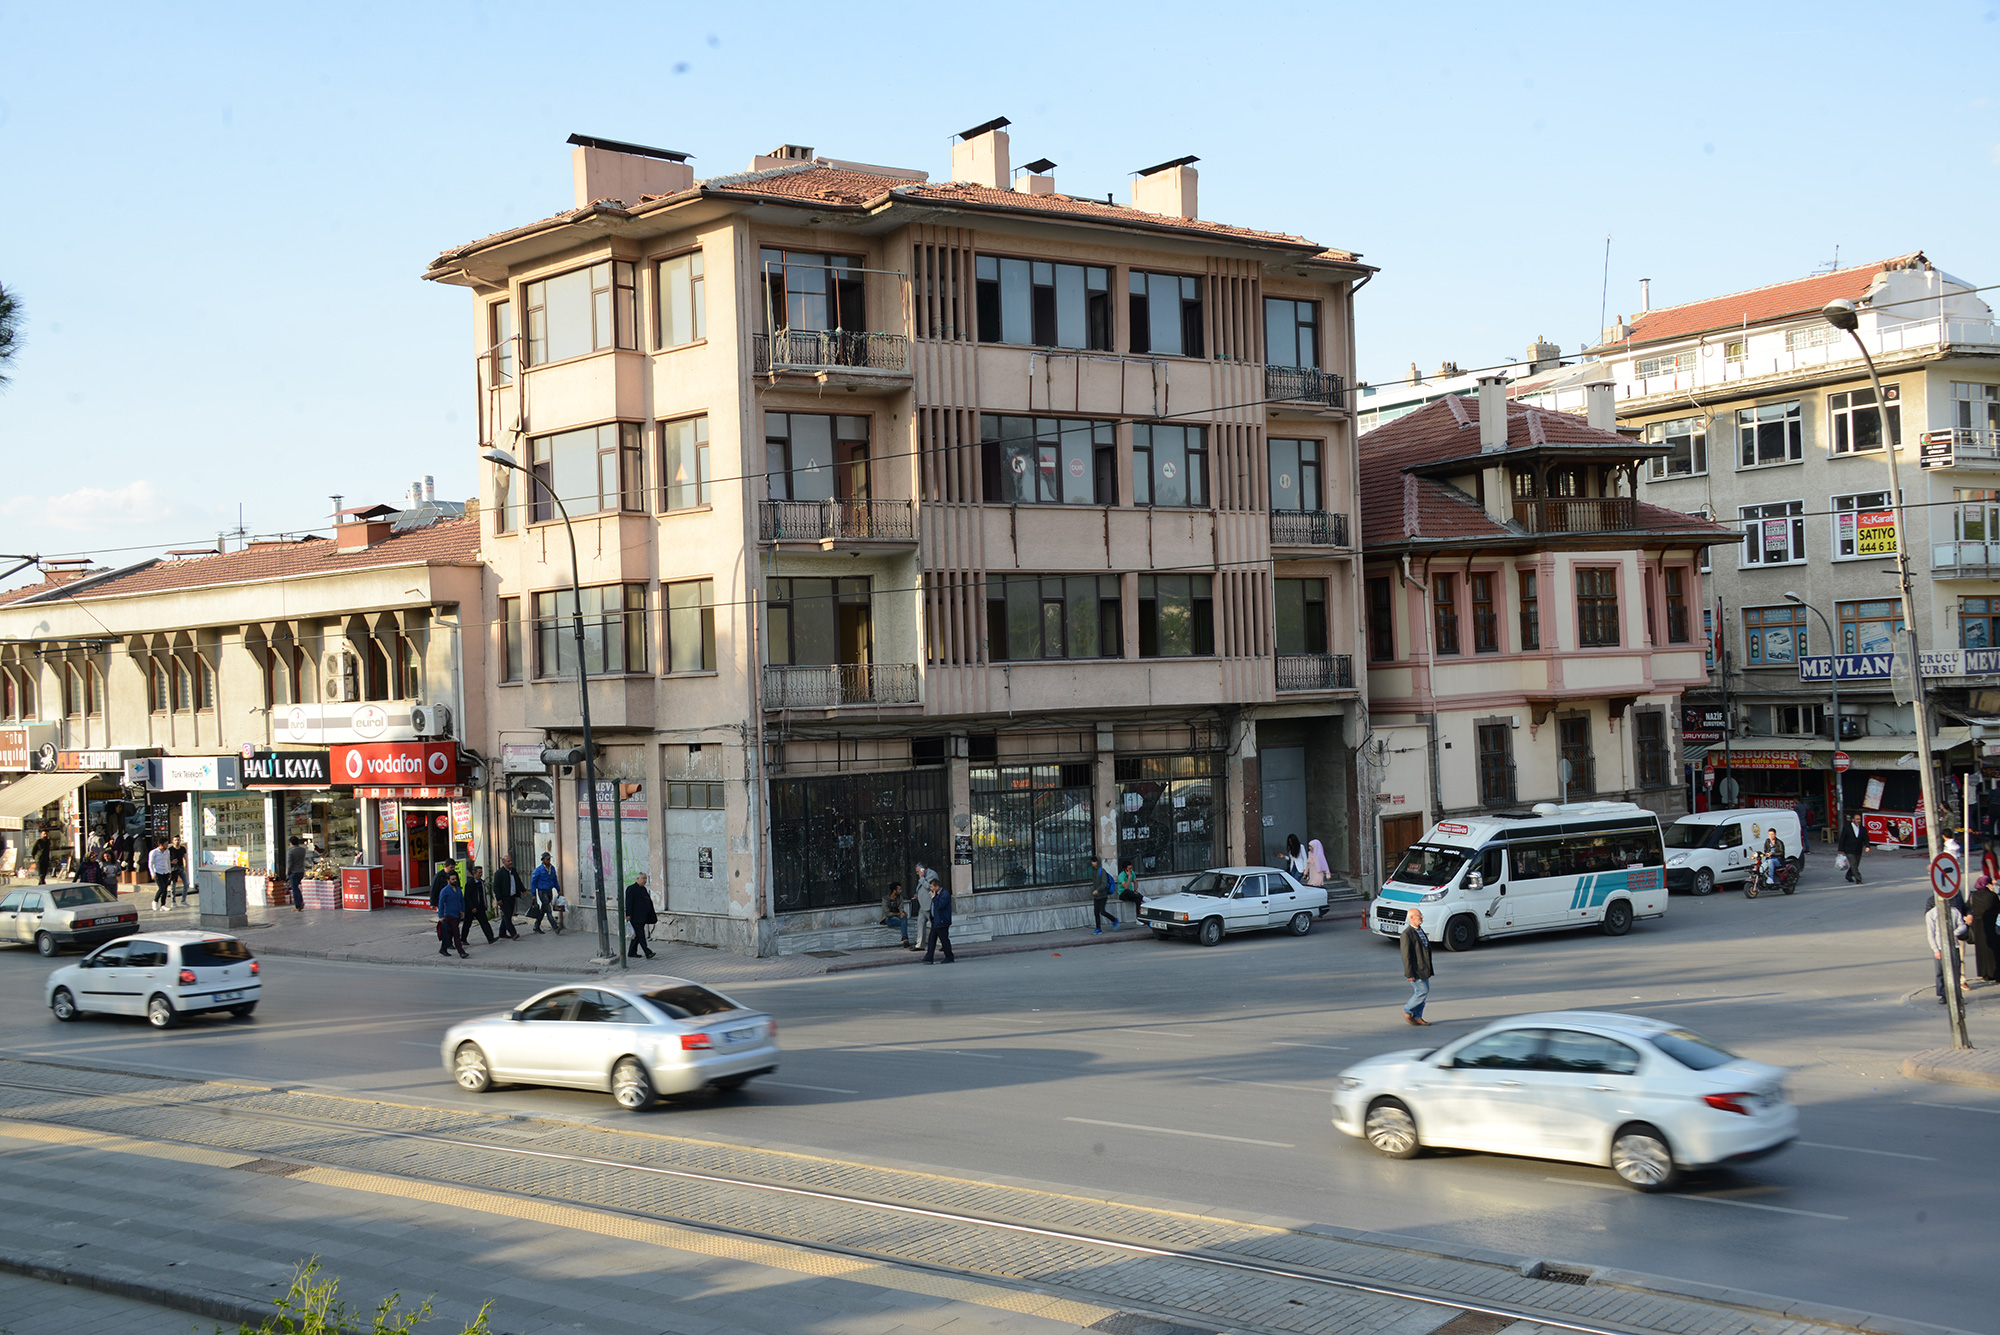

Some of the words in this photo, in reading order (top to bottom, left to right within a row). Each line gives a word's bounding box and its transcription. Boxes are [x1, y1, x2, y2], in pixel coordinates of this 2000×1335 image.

[1871, 513, 1895, 524] Karat
[1859, 527, 1896, 542] SATIYO
[1860, 542, 1877, 552] 444
[1878, 542, 1885, 551] 6
[1919, 652, 1959, 664] ÜRÜCÜ
[1966, 651, 2000, 671] MEV
[1705, 711, 1723, 720] NAZİF
[356, 717, 384, 728] eurol
[1720, 750, 1798, 760] HASBURGER
[243, 753, 284, 778] HALİL
[285, 759, 323, 778] KAYA
[172, 769, 183, 778] Türk
[183, 769, 204, 778] Telekom
[582, 792, 615, 801] SRÜCÜ
[1754, 799, 1796, 809] HASBURGE
